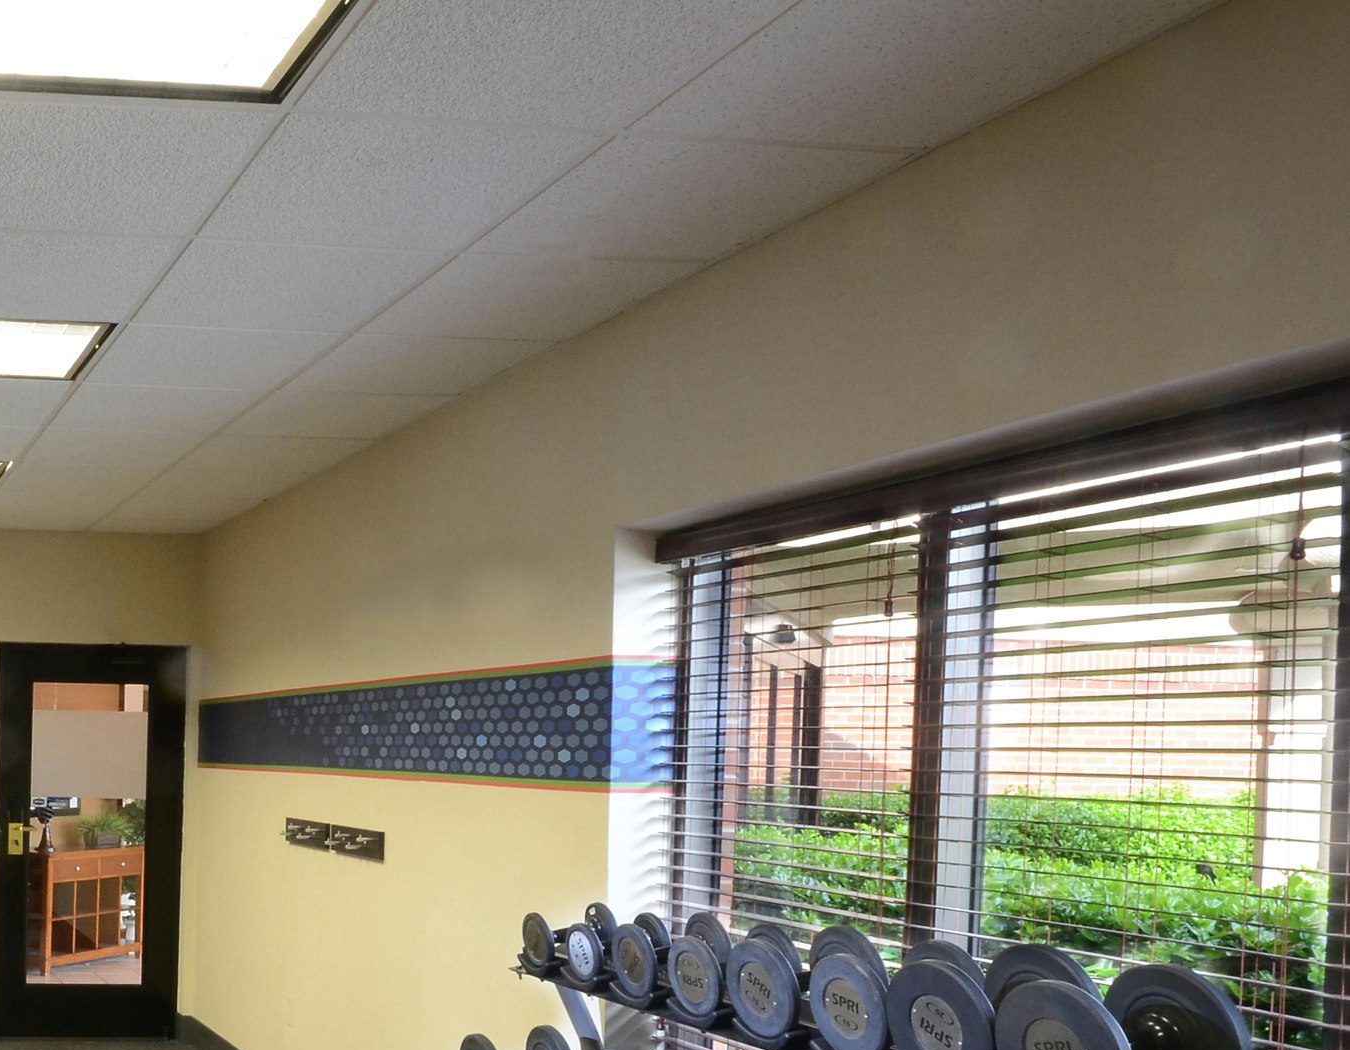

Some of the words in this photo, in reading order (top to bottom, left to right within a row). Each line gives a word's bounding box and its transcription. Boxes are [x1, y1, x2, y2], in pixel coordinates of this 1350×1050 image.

[681, 974, 702, 988] SPRI
[746, 972, 770, 999] SPRI
[832, 993, 860, 1014] SPRI
[935, 1008, 945, 1018] 20
[920, 1016, 954, 1048] SPRI
